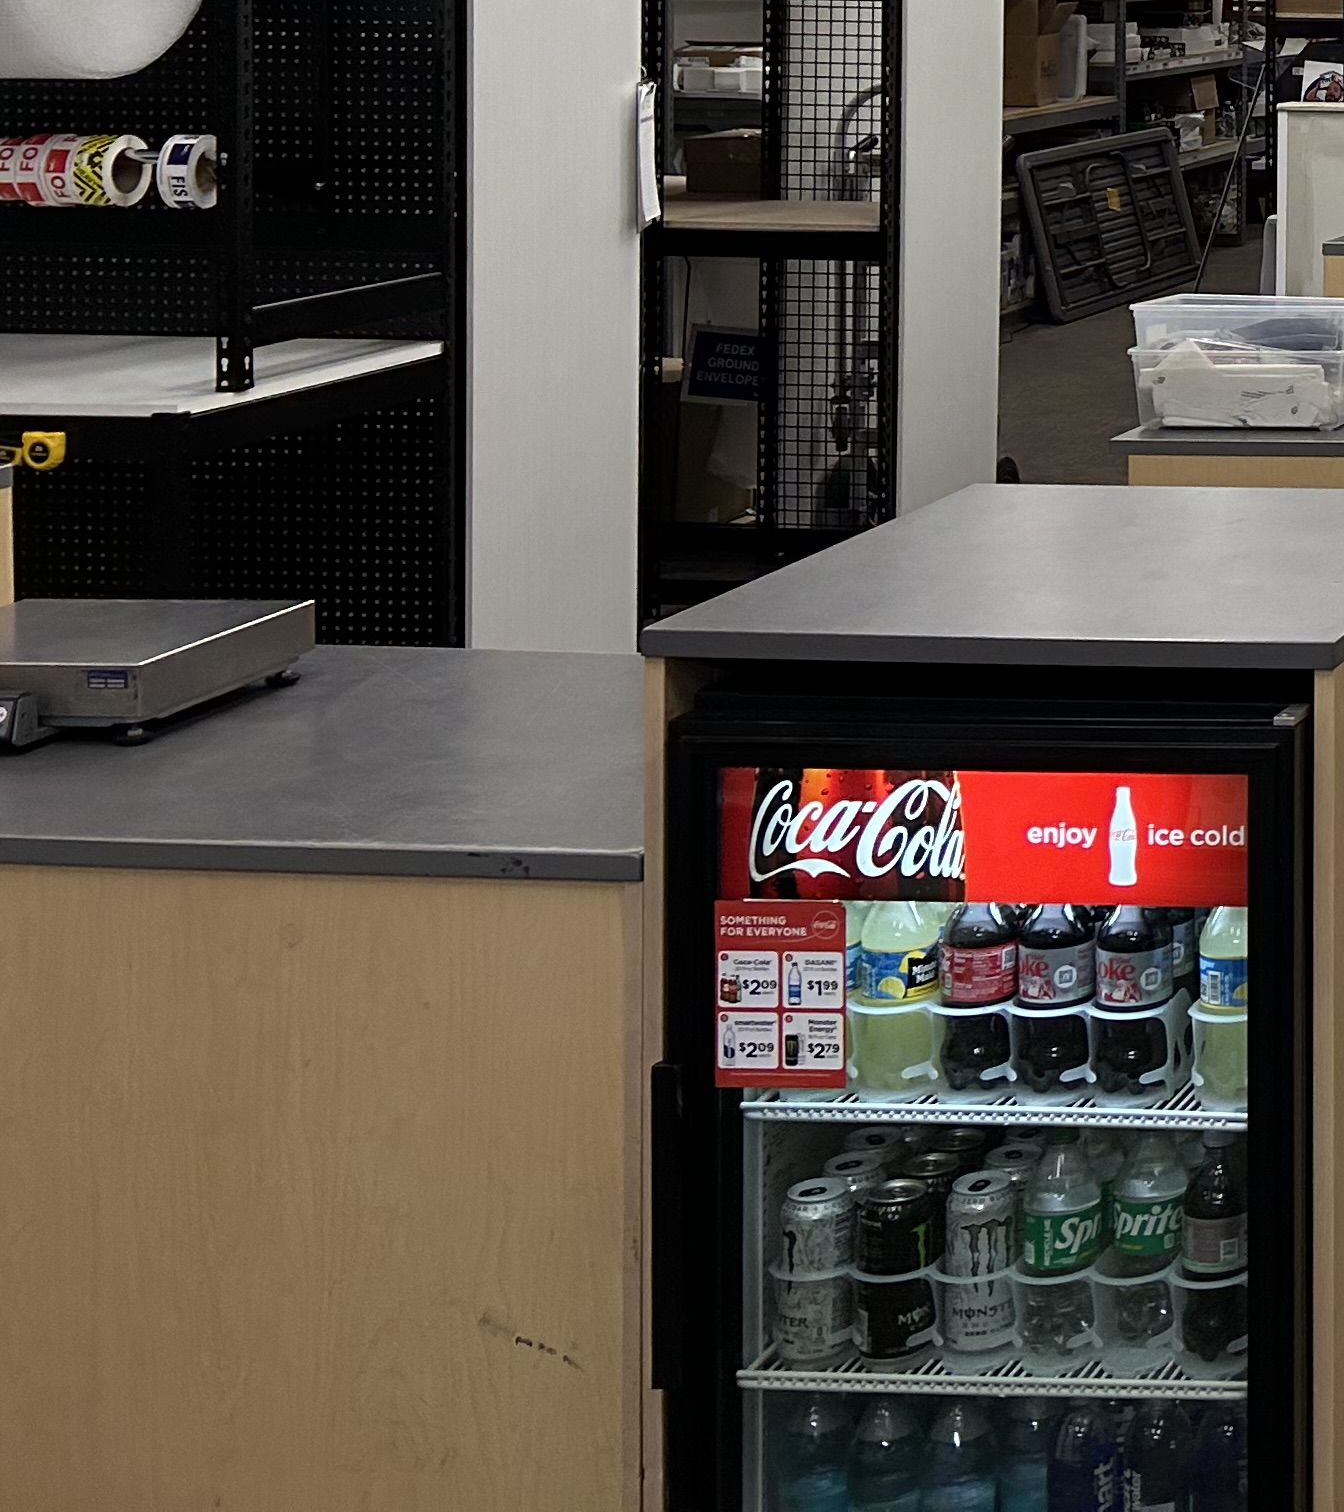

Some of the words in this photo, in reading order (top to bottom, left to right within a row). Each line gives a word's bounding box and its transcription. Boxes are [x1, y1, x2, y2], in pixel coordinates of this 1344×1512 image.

[715, 342, 755, 357] FEDEX
[707, 357, 759, 371] GROUND
[749, 779, 965, 882] Coca-Cola
[1027, 822, 1097, 849] enjoy
[1148, 823, 1185, 846] ice
[1191, 823, 1245, 847] cold
[720, 916, 787, 926] SOMETHING
[720, 927, 744, 937] FOR
[746, 927, 807, 937] EVERYONE
